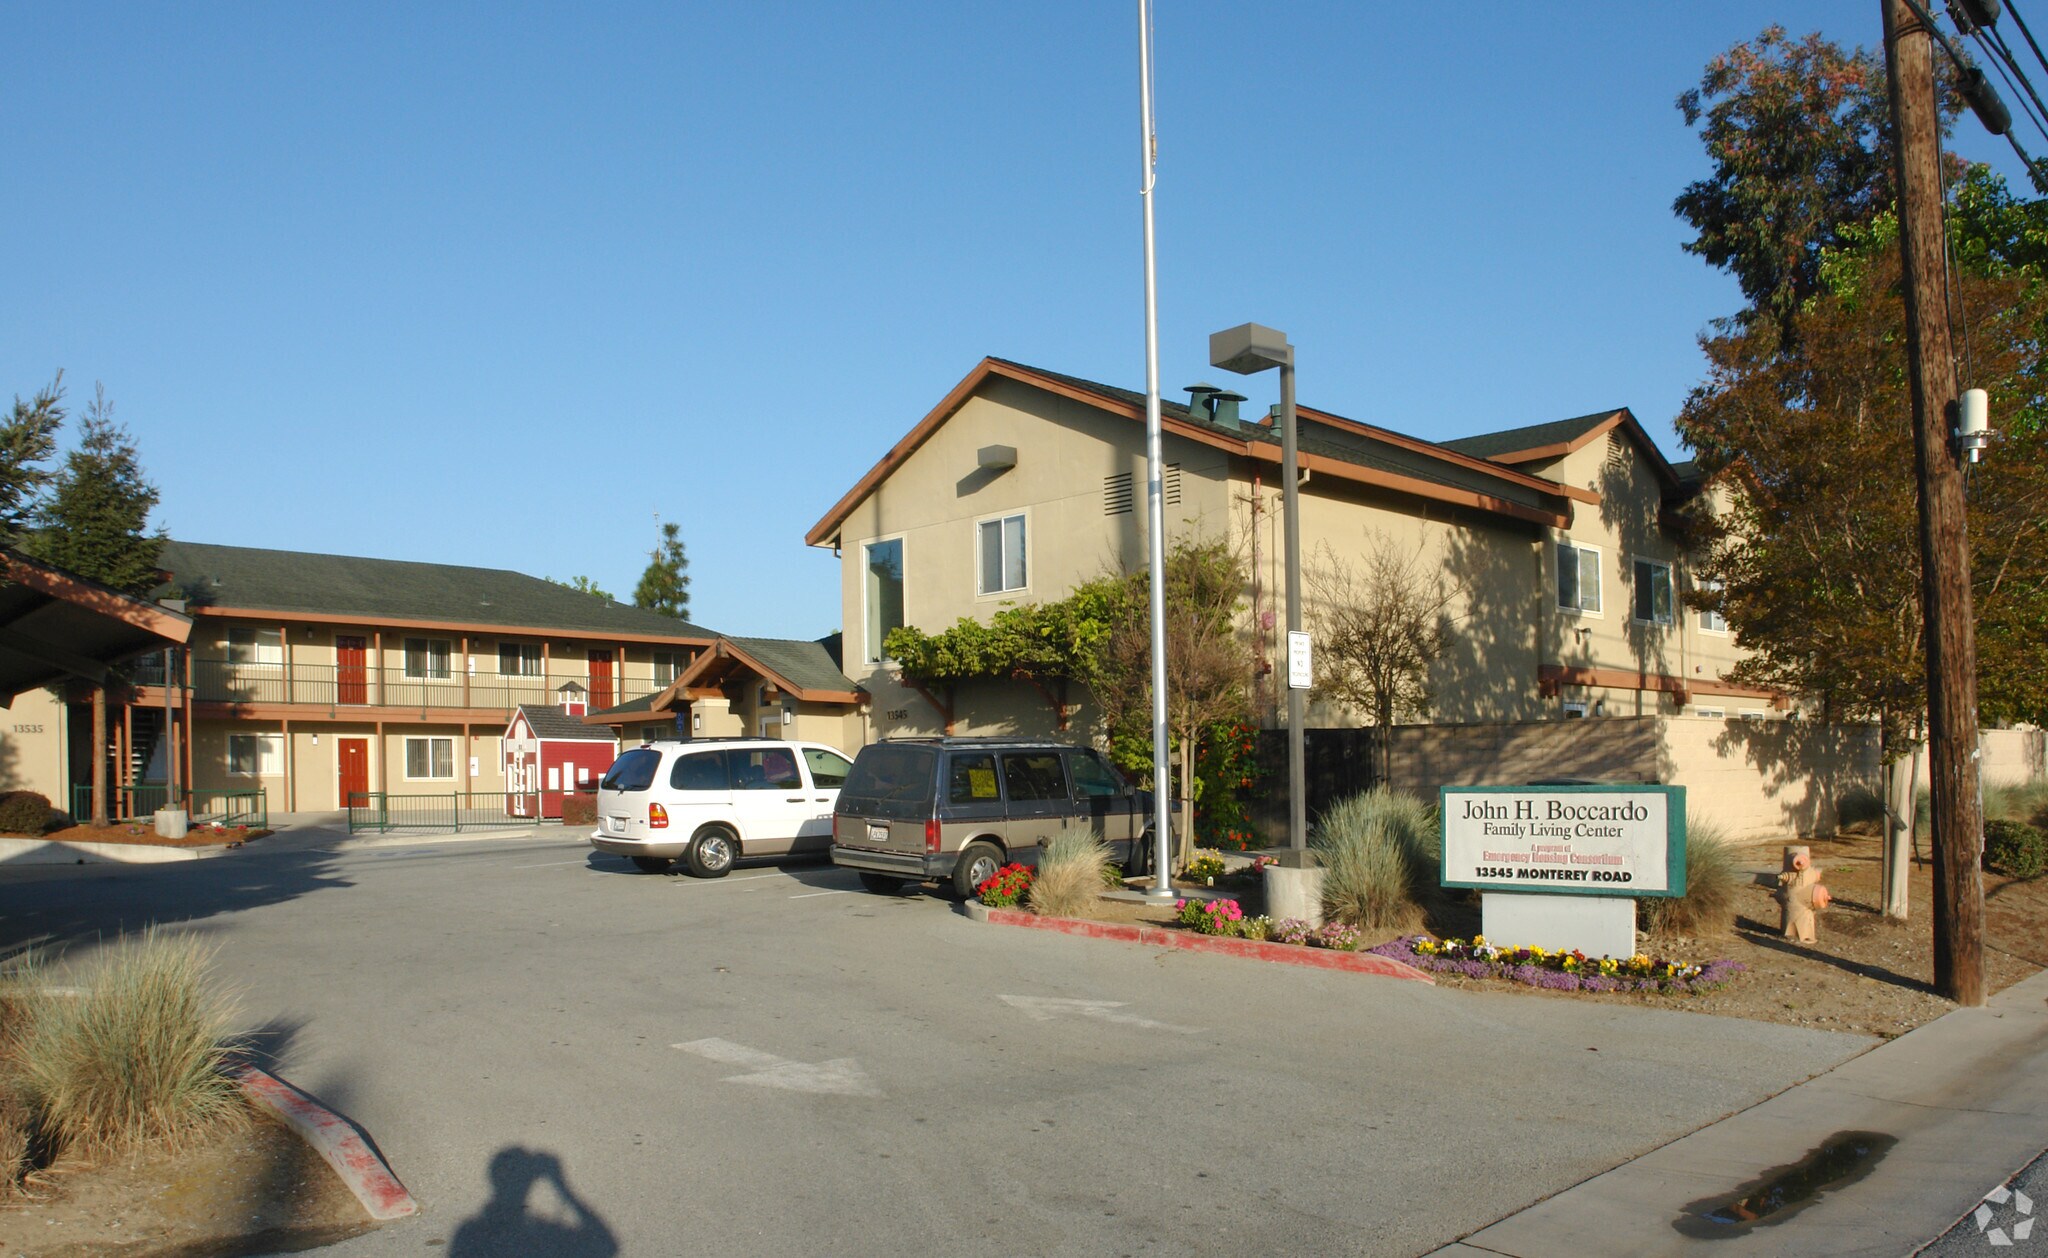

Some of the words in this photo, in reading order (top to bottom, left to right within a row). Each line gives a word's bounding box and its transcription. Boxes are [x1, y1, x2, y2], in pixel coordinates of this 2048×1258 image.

[887, 709, 908, 720] 13545
[13, 724, 44, 734] 13535
[1462, 800, 1508, 820] John
[1514, 800, 1539, 820] H.
[1546, 800, 1649, 821] Boccardo
[1483, 822, 1526, 839] Family
[1530, 823, 1571, 840] Living
[1574, 823, 1623, 838] Center
[1482, 850, 1531, 863] Emergency
[1532, 852, 1569, 864] Housing
[1570, 853, 1624, 866] Consortium
[1475, 867, 1513, 878] 13545
[1516, 868, 1589, 881] MONTEREY
[1592, 871, 1632, 882] ROAD
